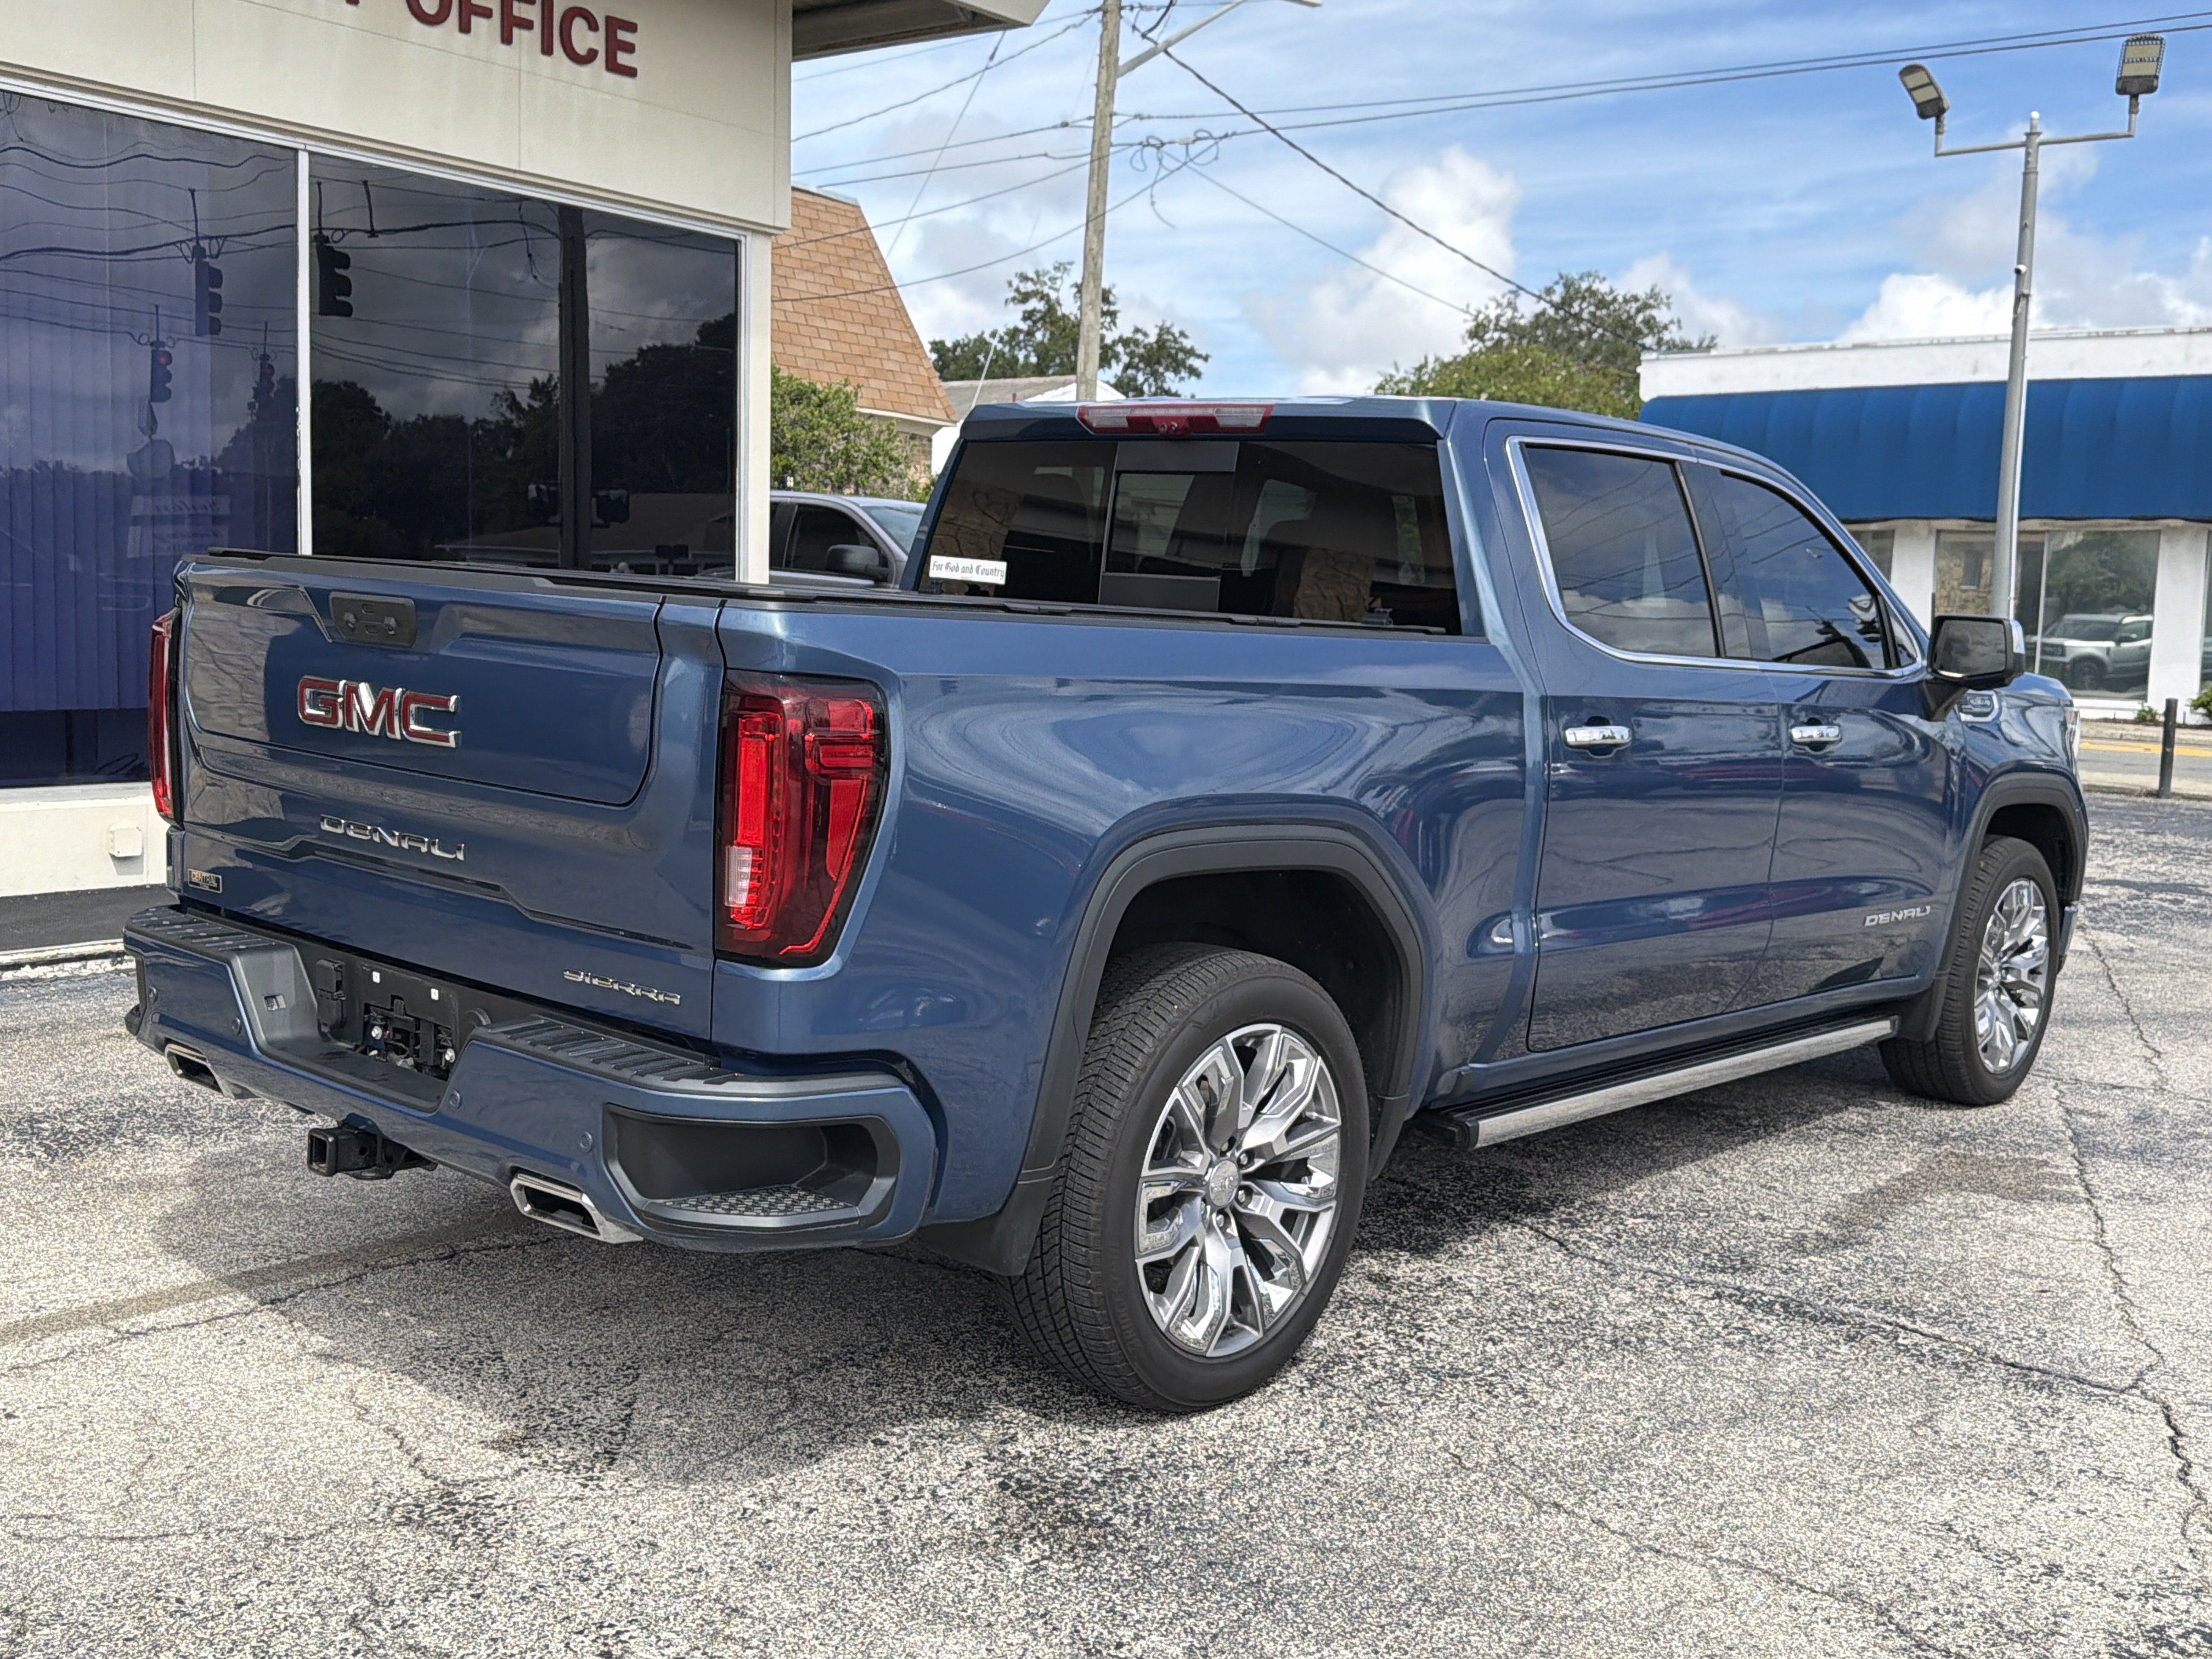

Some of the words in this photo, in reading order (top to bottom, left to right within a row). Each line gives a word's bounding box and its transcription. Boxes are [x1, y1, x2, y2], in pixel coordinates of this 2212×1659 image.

[932, 561, 943, 572] For
[945, 561, 960, 573] God
[961, 563, 974, 574] and
[975, 565, 1005, 580] Country
[297, 675, 461, 748] GMC
[320, 814, 464, 861] DENALI
[1865, 905, 1931, 927] DENALI
[563, 968, 681, 1006] SIERRA
